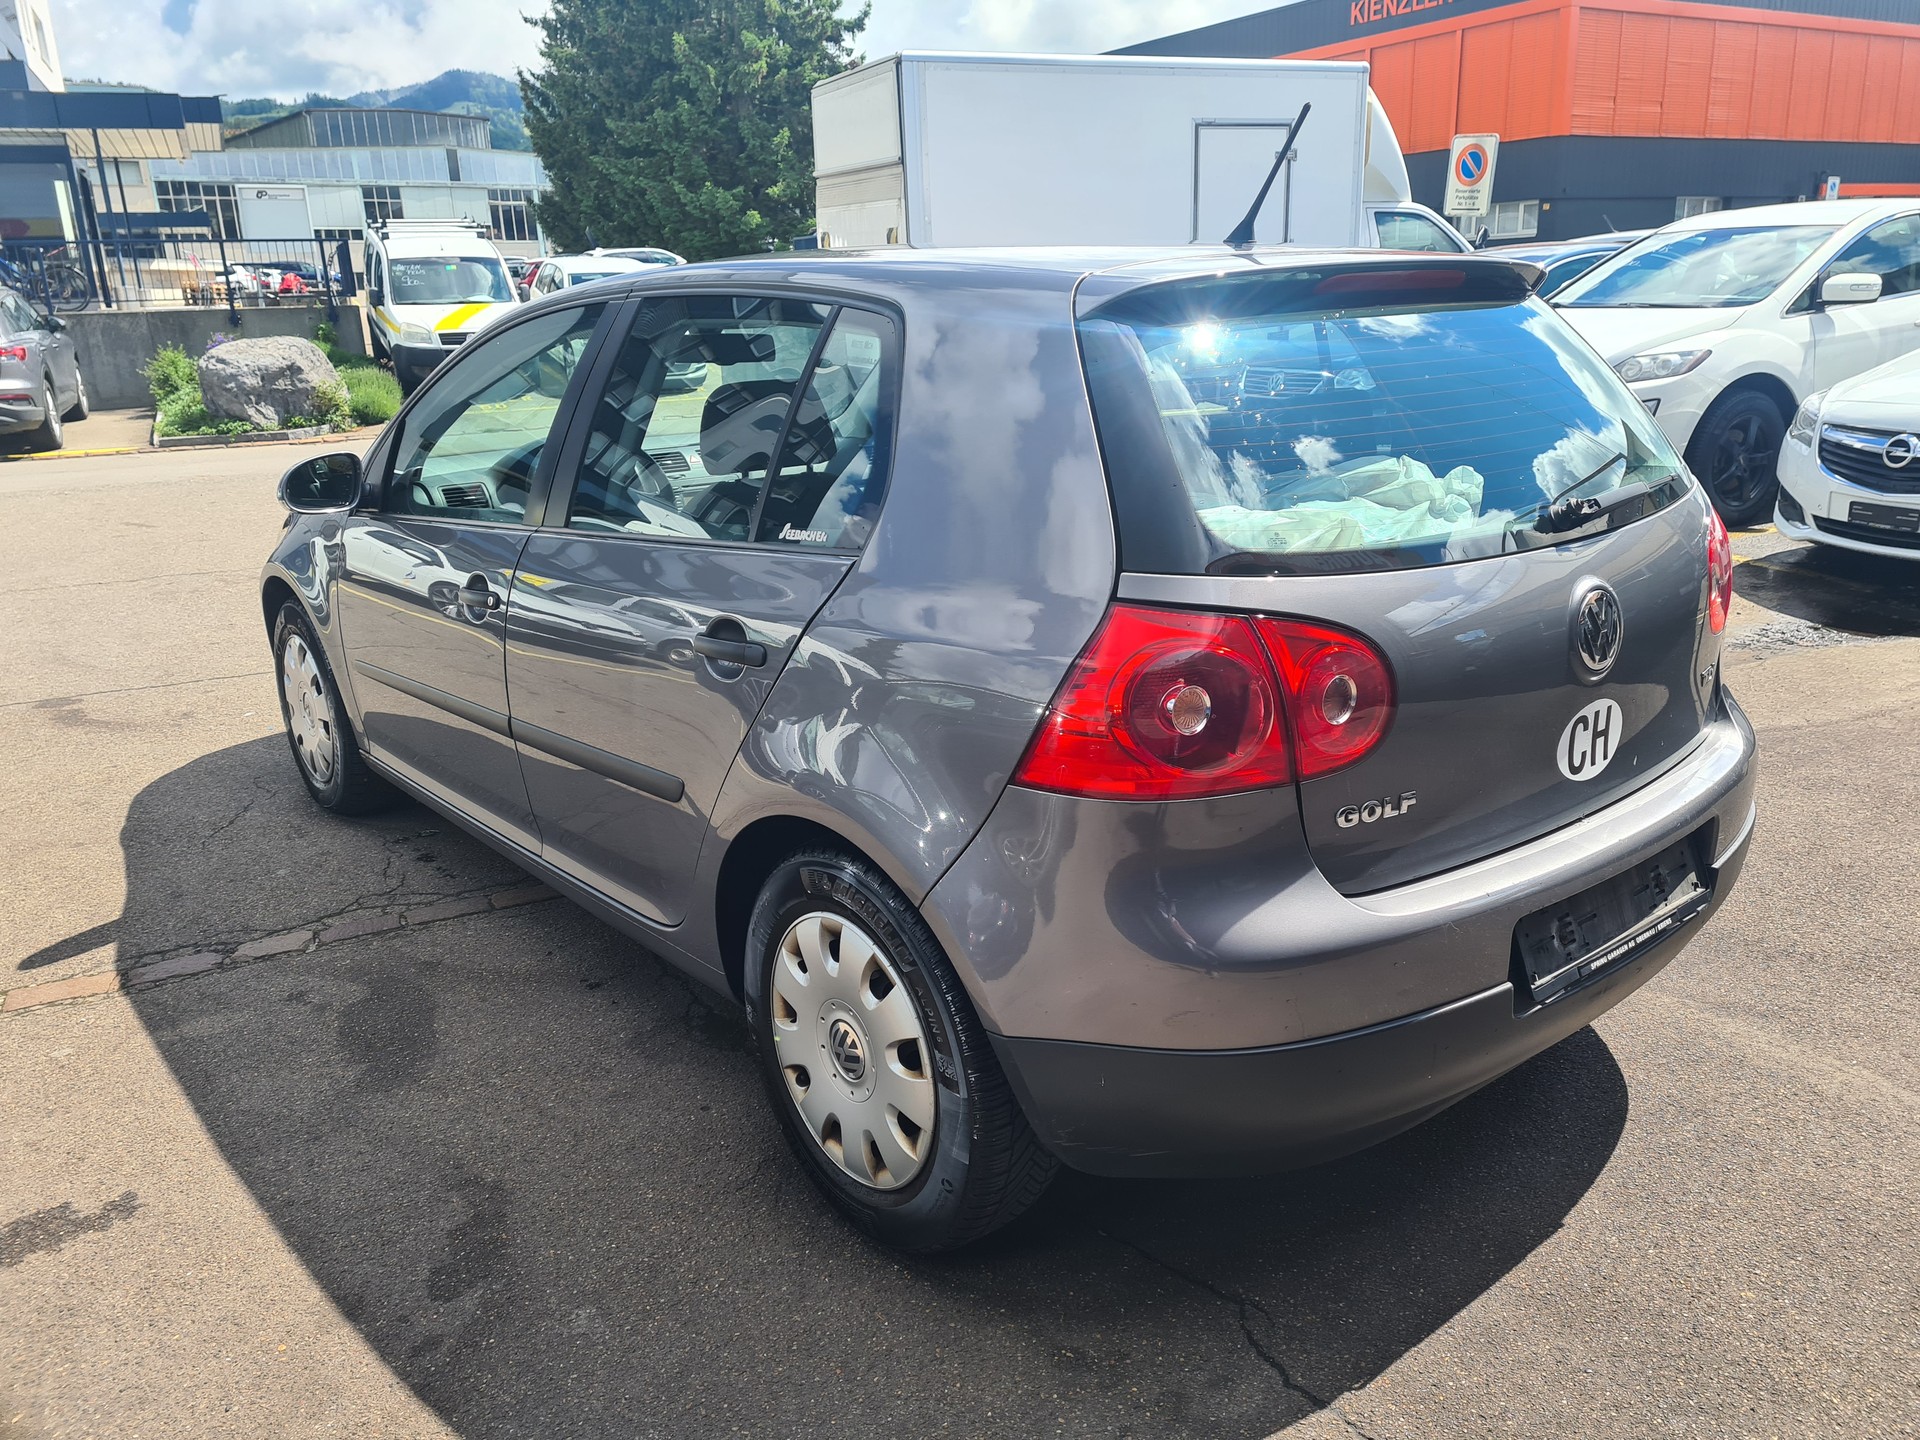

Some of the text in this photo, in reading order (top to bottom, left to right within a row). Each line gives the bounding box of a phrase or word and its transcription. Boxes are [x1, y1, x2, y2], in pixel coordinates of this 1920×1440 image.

[1350, 0, 1453, 25] KIENZL
[1568, 704, 1613, 776] CH
[1335, 790, 1417, 828] GOLF
